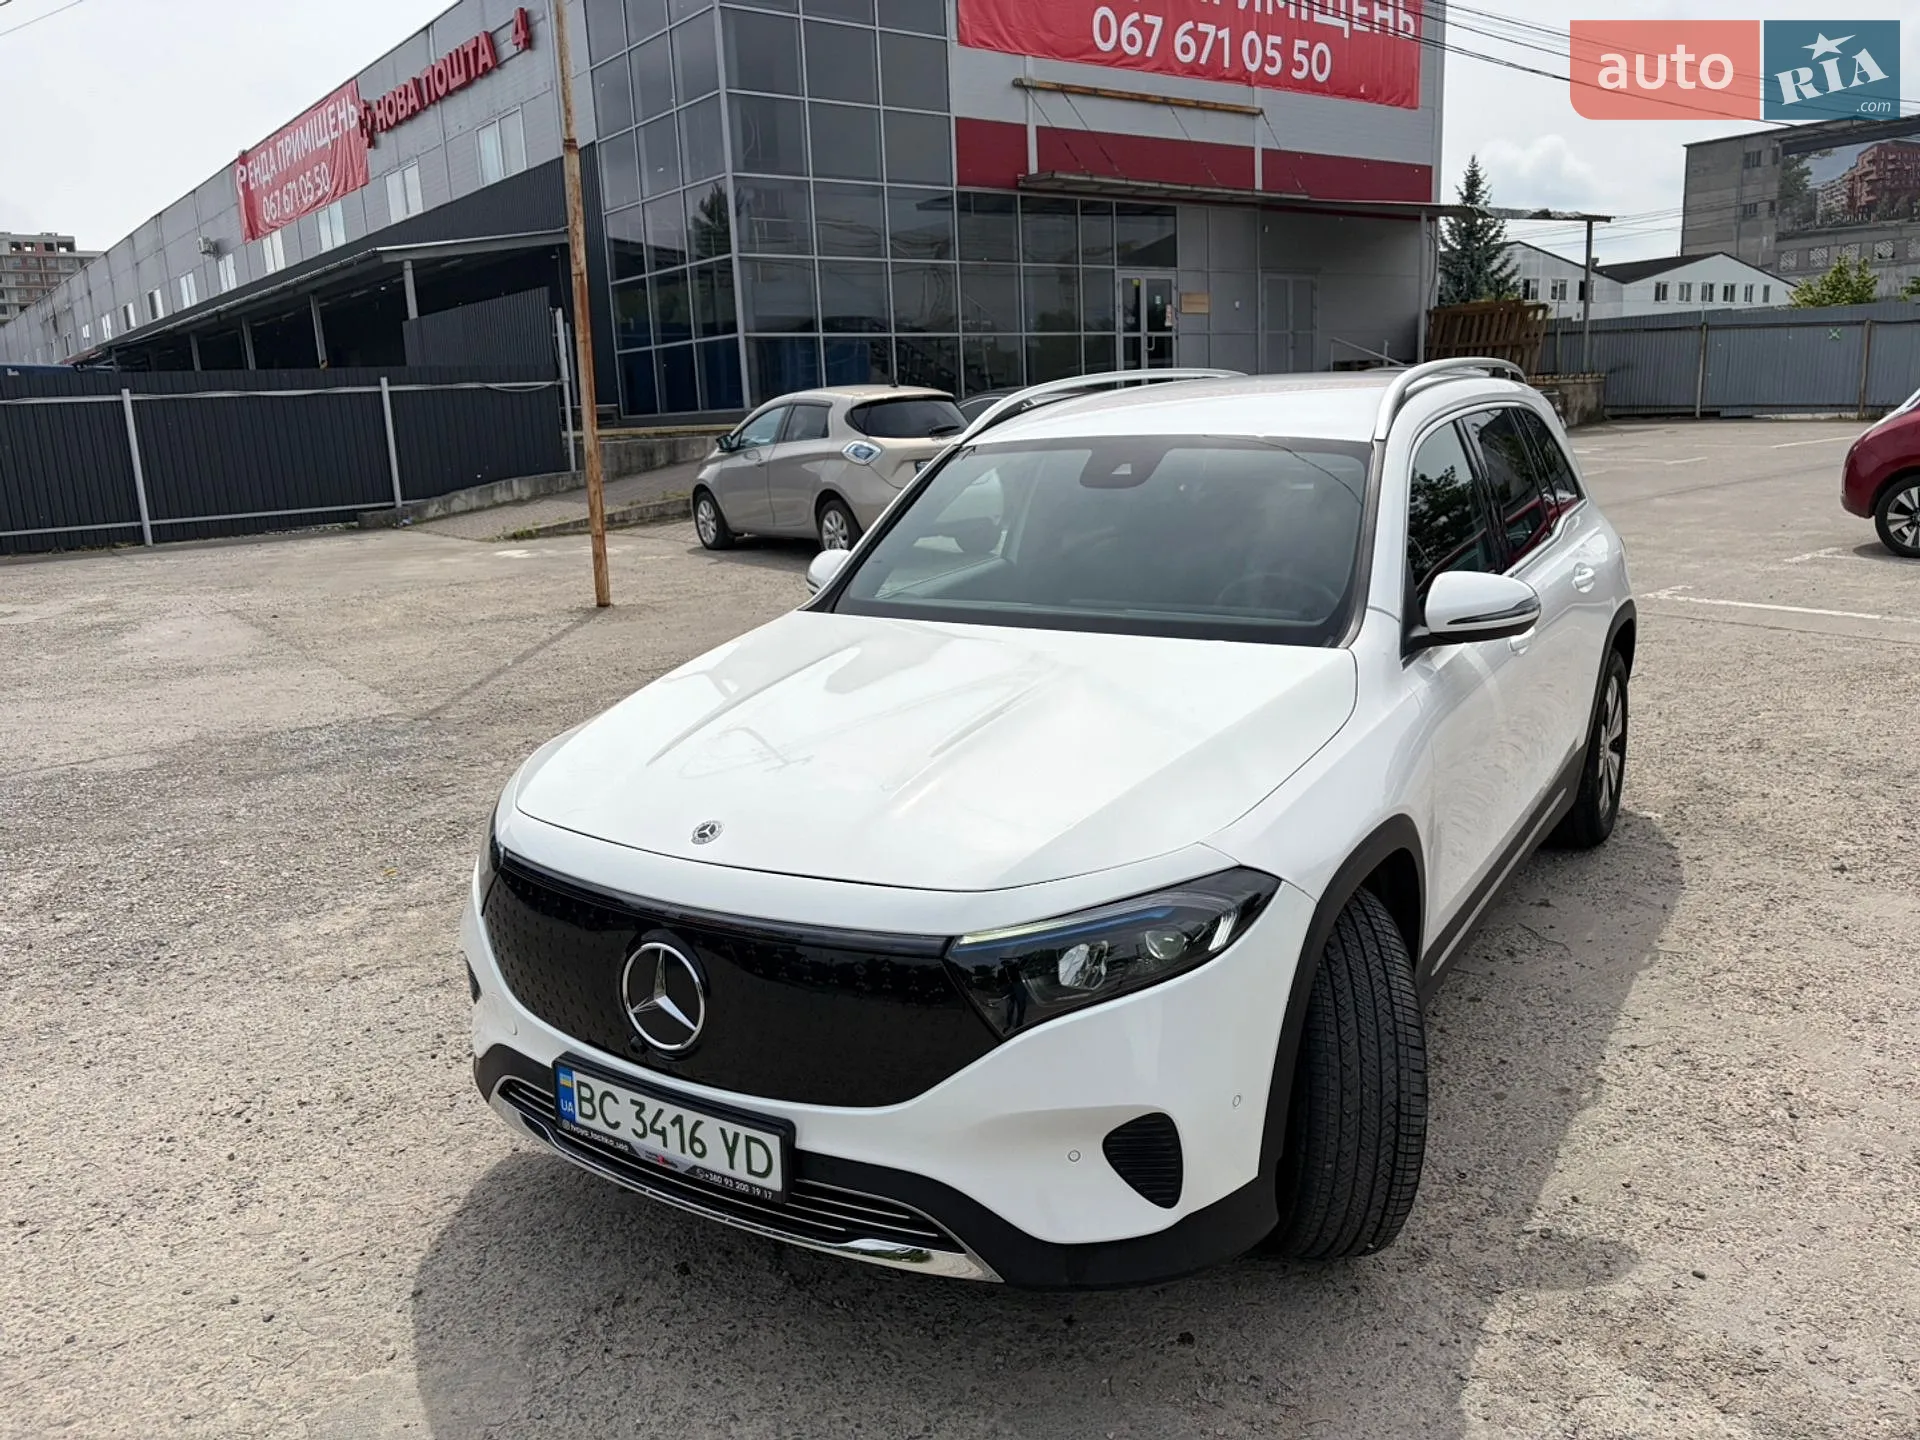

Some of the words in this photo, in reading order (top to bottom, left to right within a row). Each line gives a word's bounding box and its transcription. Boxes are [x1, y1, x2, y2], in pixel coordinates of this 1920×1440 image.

[375, 77, 424, 132] НОВА
[421, 30, 498, 105] ПОШТА
[511, 7, 531, 50] 4
[1092, 6, 1163, 57] 067
[1174, 20, 1231, 68] 671
[1242, 30, 1283, 76] 05
[1291, 39, 1332, 83] 50
[276, 95, 358, 172] ПРИМІЩЕНЬ
[262, 190, 282, 223] 067
[283, 181, 301, 213] 671
[300, 171, 314, 204] 05
[315, 162, 331, 197] 50
[560, 1098, 575, 1114] UA
[577, 1080, 621, 1130] BC
[630, 1098, 707, 1159] 3416
[719, 1126, 774, 1179] YD
